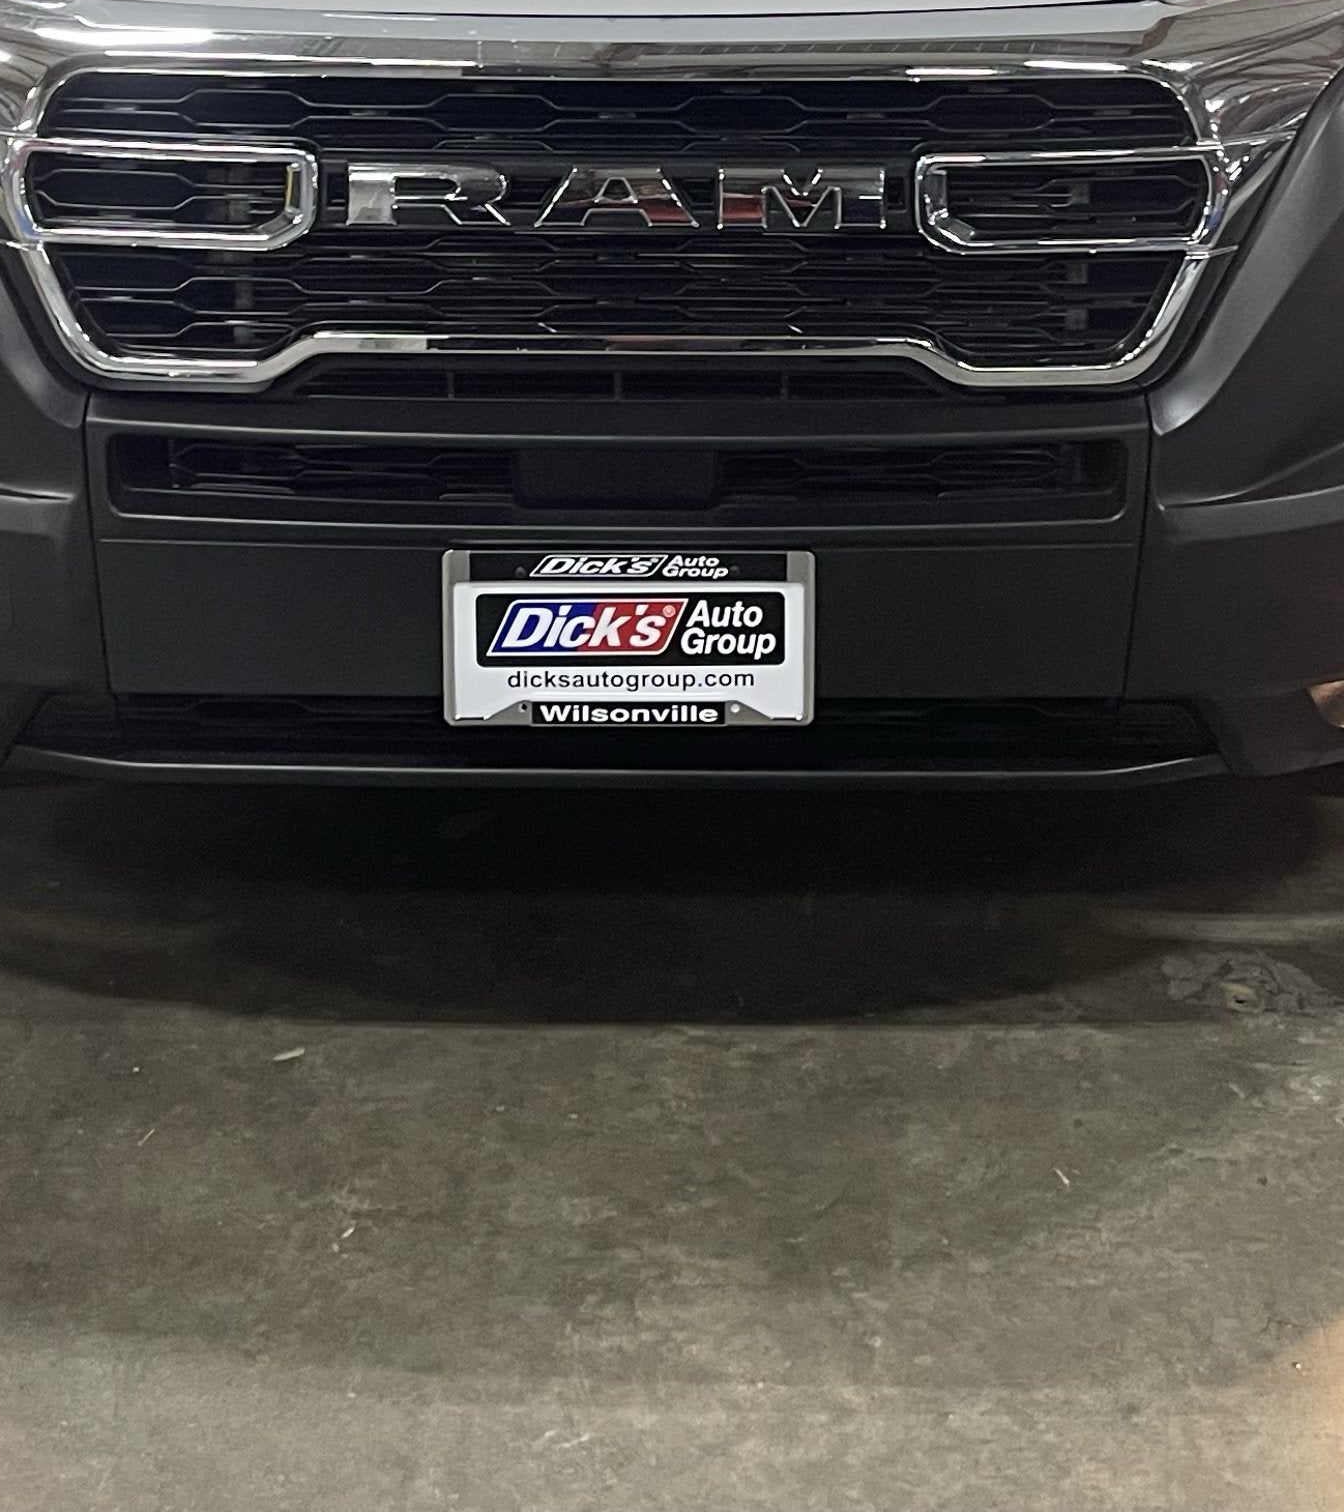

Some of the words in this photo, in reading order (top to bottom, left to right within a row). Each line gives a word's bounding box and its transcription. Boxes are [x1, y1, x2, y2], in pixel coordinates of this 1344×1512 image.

[346, 162, 887, 229] RAM
[662, 565, 729, 579] Group
[671, 554, 720, 568] Auto
[501, 603, 665, 649] Dick's
[686, 599, 763, 628] Auto
[680, 629, 776, 660] Group
[507, 670, 755, 692] dicksautogroup.com
[539, 704, 719, 723] Wilsonville
